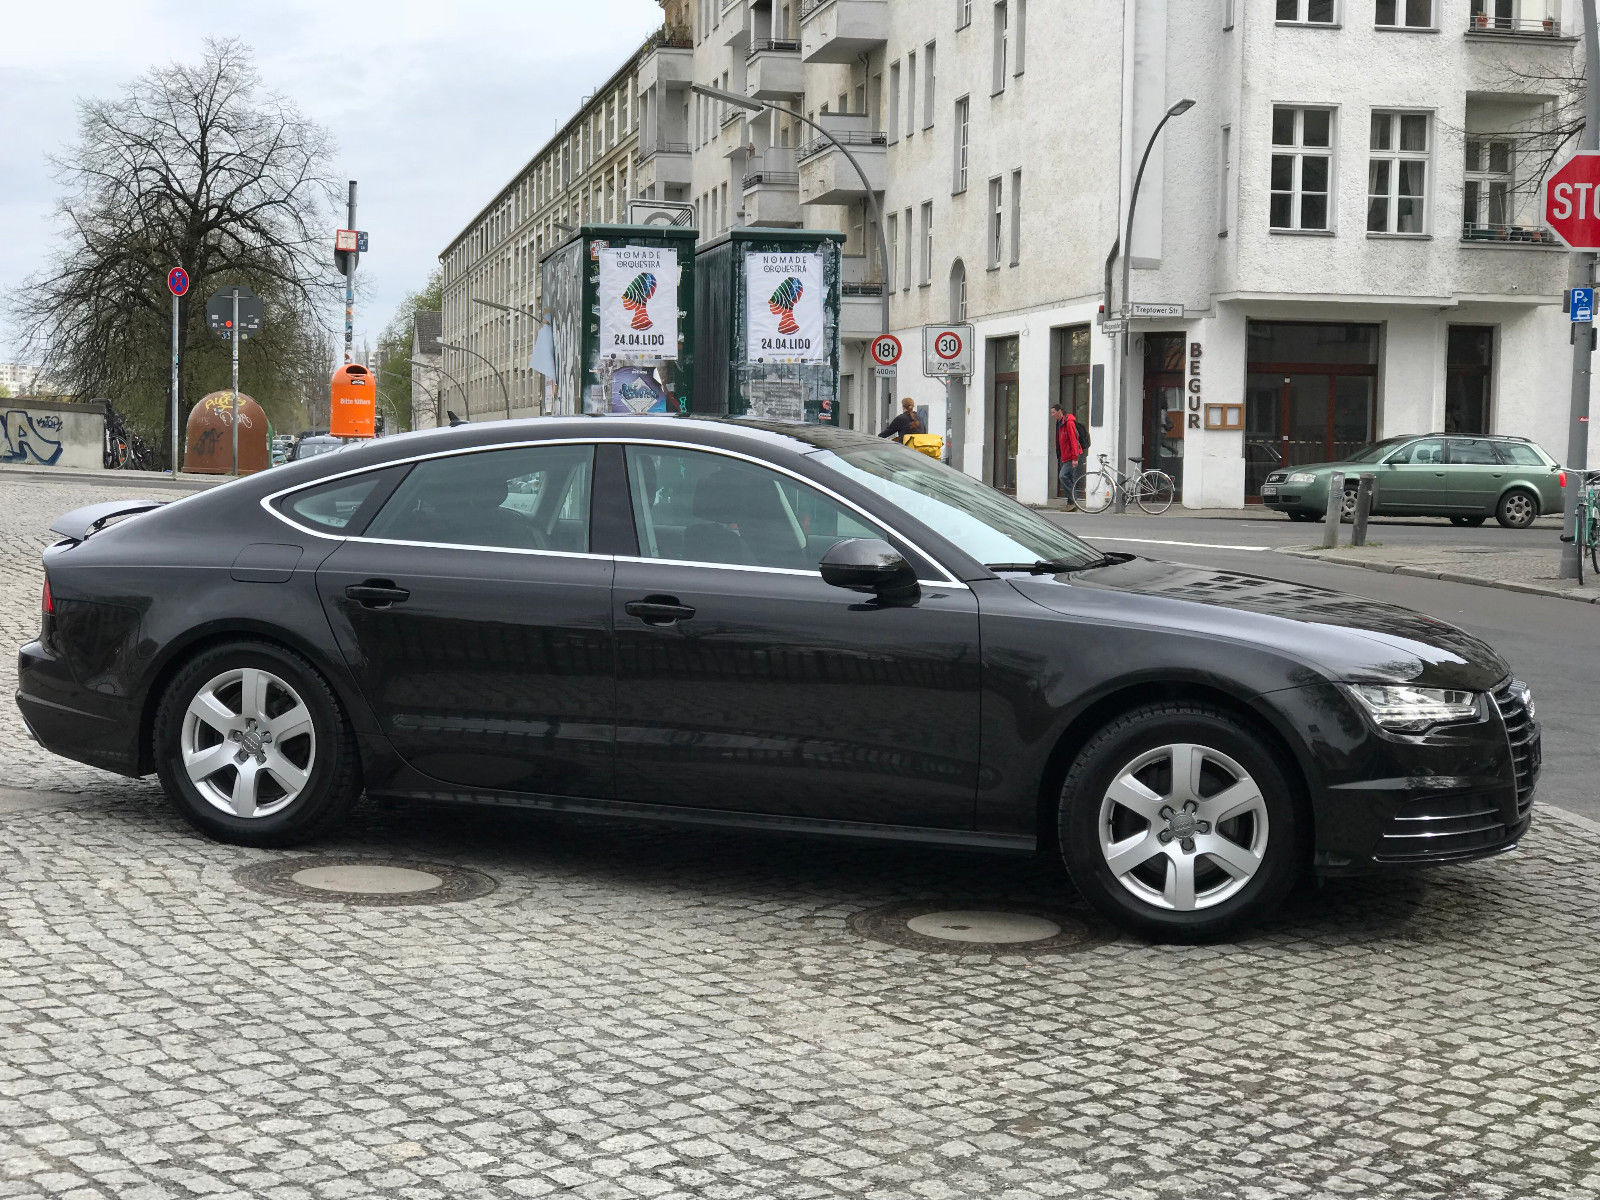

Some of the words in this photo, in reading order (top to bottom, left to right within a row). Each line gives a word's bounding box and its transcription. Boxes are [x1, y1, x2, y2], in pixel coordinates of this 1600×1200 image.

[616, 251, 661, 259] NOMADE
[763, 256, 807, 264] NOMADE
[616, 260, 661, 269] ORQUESTRA
[763, 265, 807, 273] ORQUESTRA
[1574, 290, 1585, 304] P
[1136, 305, 1167, 315] Treptower
[1168, 307, 1180, 315] Str.
[614, 334, 665, 346] 24.04.LIDO
[761, 338, 811, 350] 24.04.LIDO
[940, 339, 957, 352] 30
[877, 342, 896, 358] 18t
[1188, 342, 1203, 429] BEGUR
